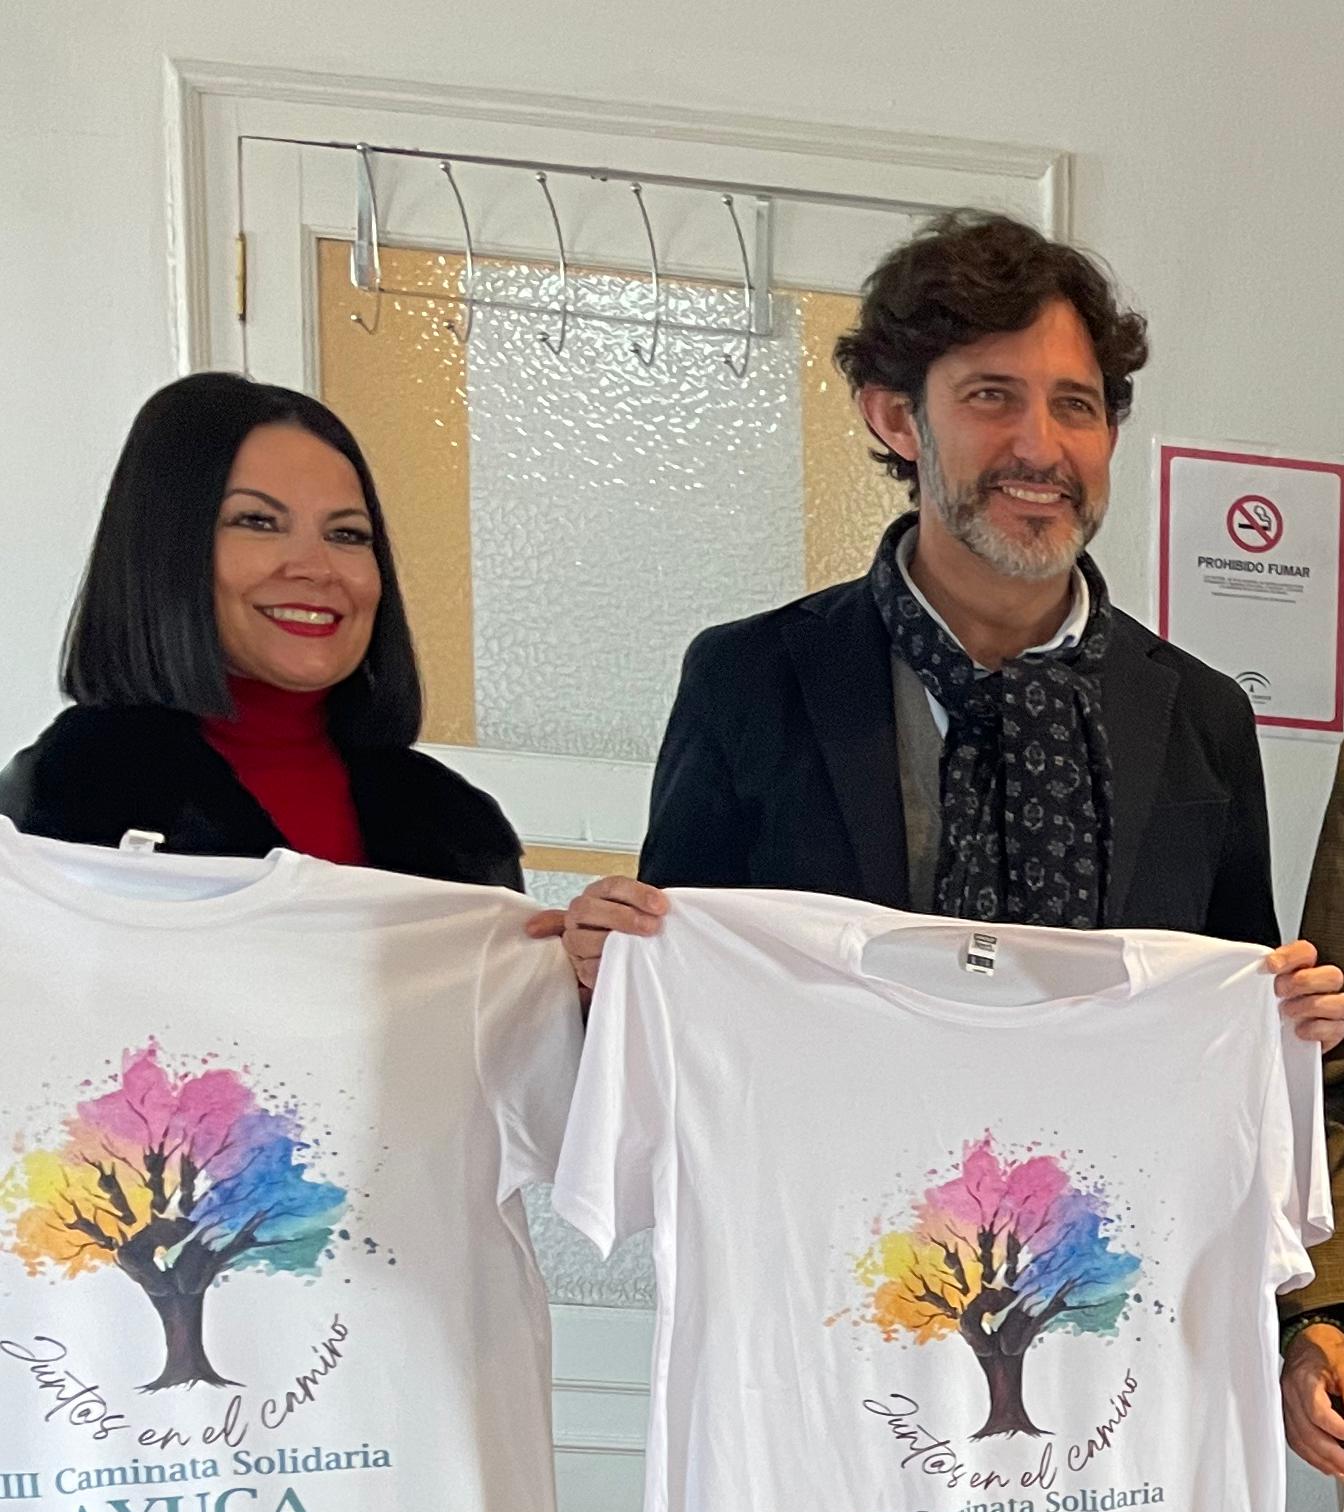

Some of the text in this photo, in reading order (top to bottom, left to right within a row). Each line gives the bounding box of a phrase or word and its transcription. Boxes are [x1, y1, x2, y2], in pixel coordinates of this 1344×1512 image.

[1197, 556, 1311, 579] PROHIBIDO FUMAR
[54, 1457, 221, 1496] Caminata
[232, 1443, 393, 1477] Solidaria
